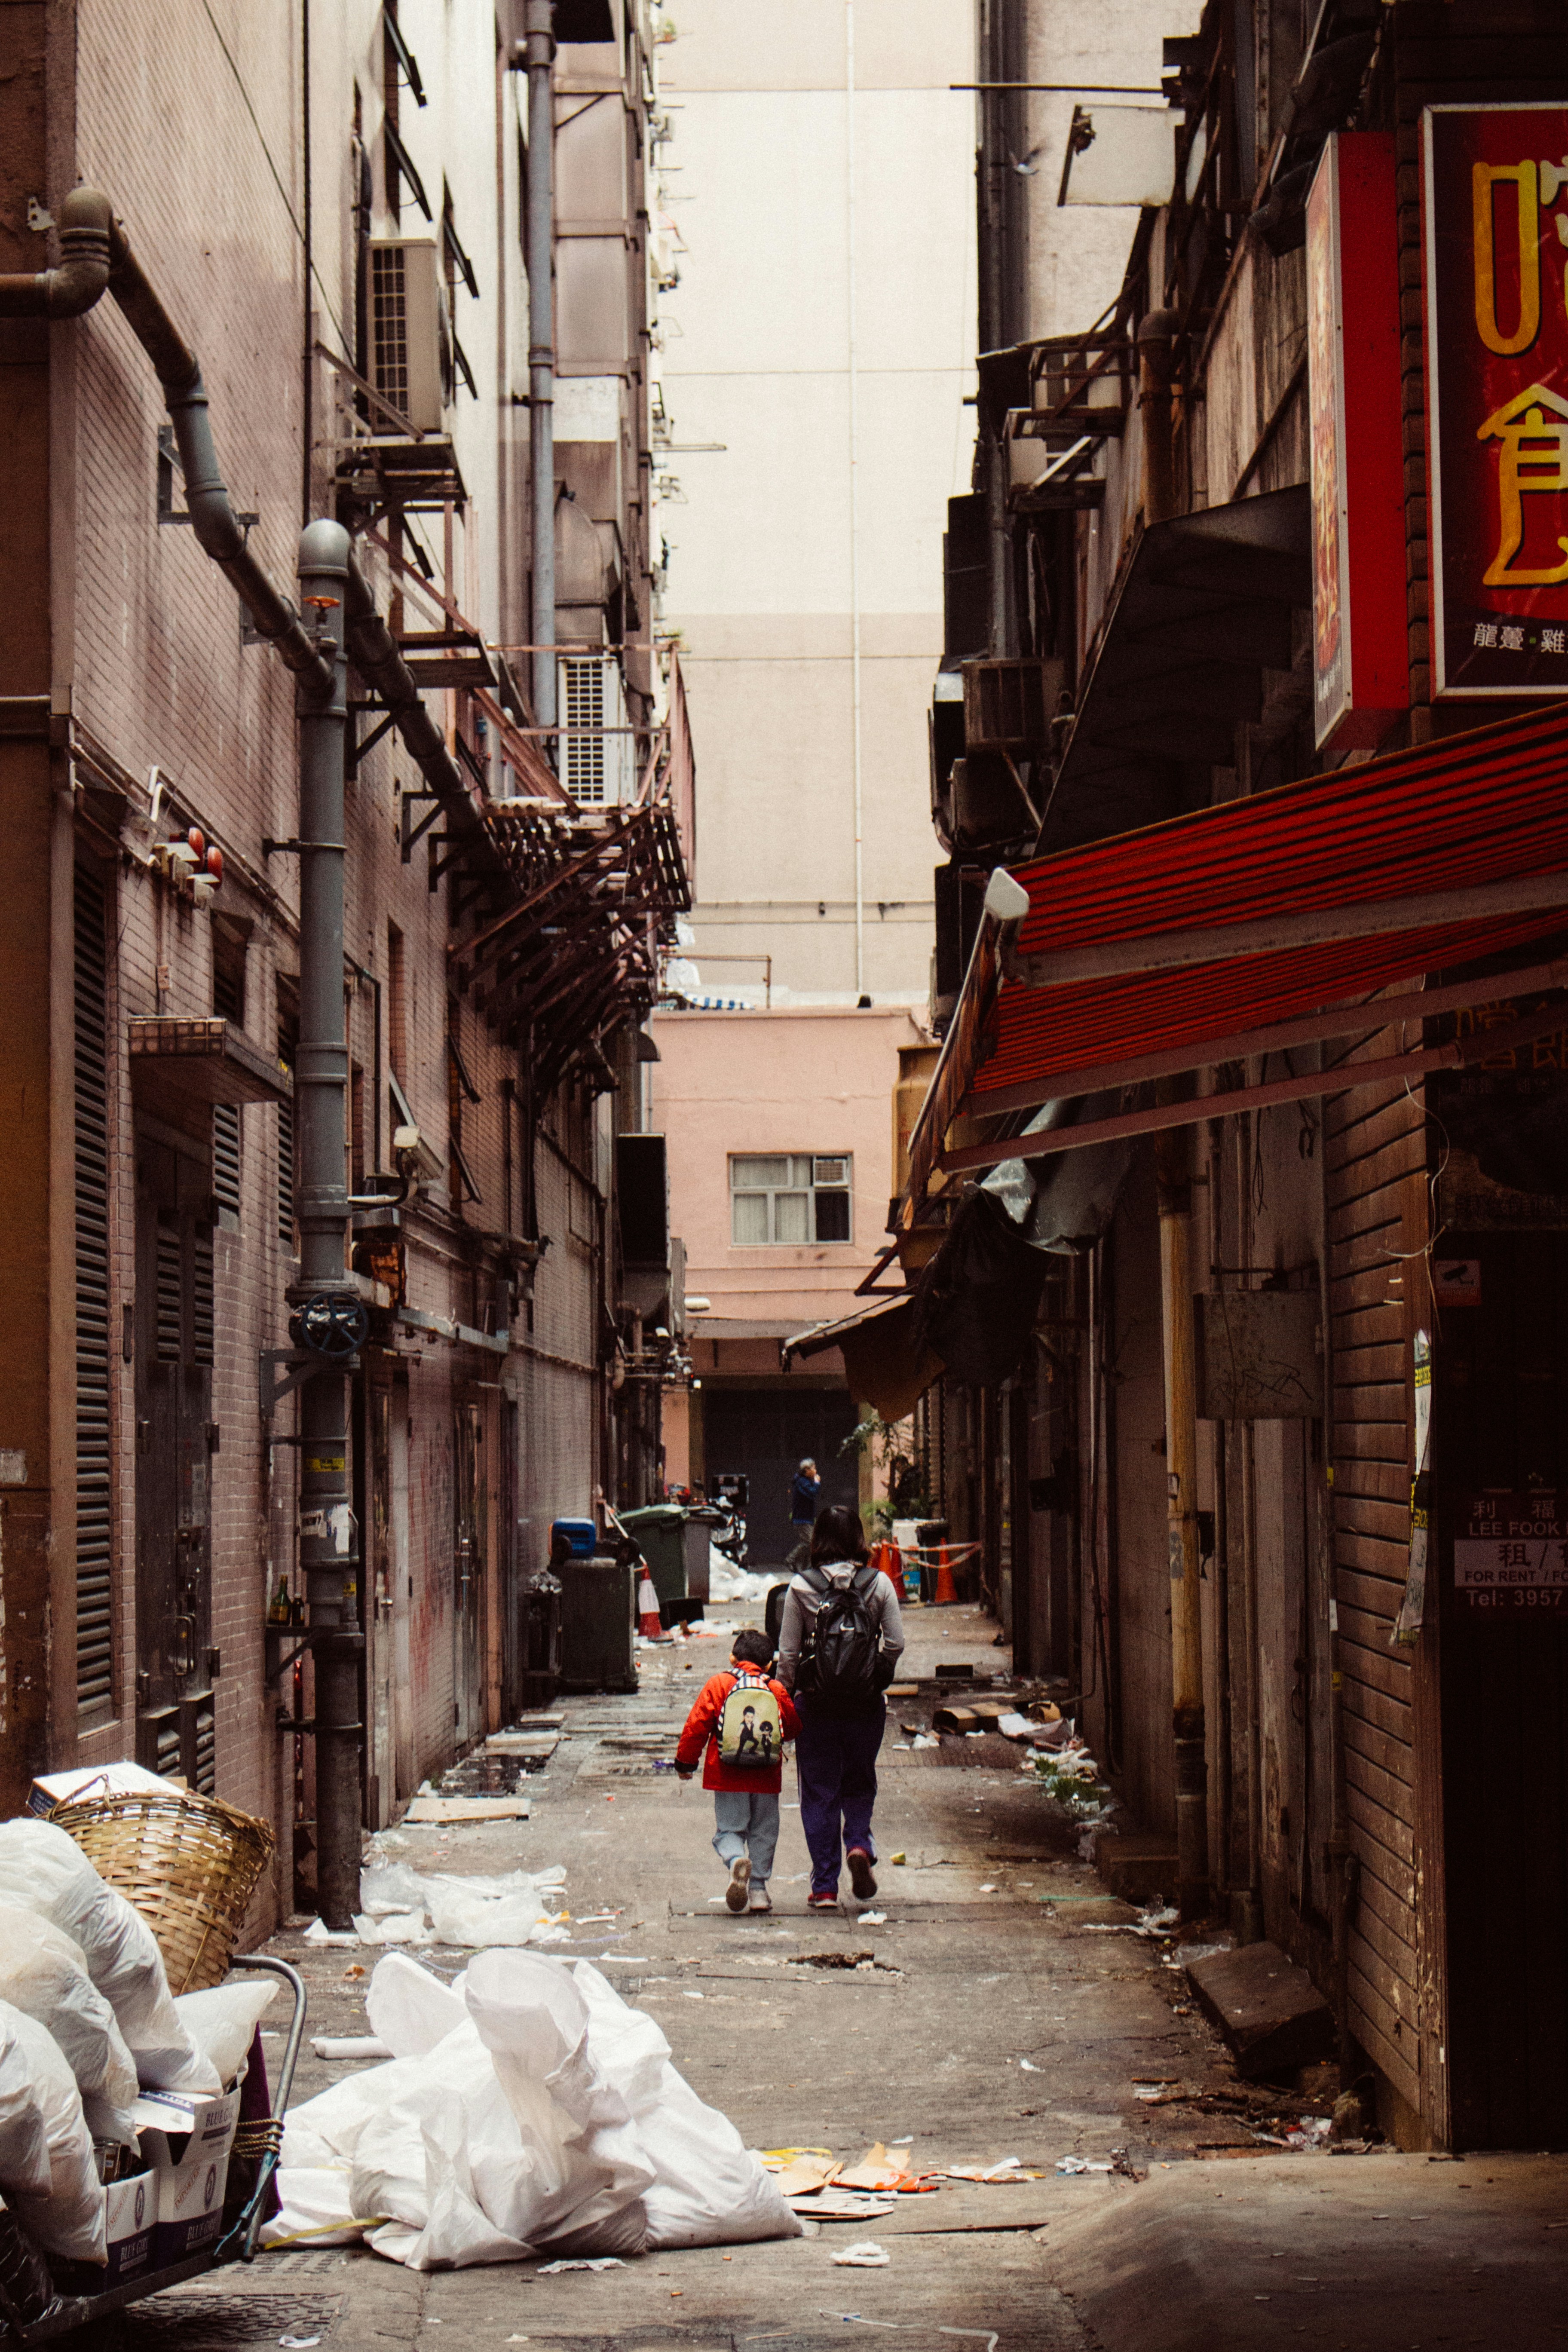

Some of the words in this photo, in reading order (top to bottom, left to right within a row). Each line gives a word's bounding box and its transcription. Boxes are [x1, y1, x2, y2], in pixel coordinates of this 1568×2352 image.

[1469, 1521, 1503, 1537] LEE
[1509, 1521, 1560, 1537] FOOK
[1464, 1570, 1494, 1582] FOR
[1499, 1570, 1536, 1582] RENT
[1466, 1589, 1504, 1607] Tel:
[1513, 1589, 1564, 1607] 3957
[205, 2109, 224, 2128] BLUE
[120, 2242, 136, 2262] BLUE
